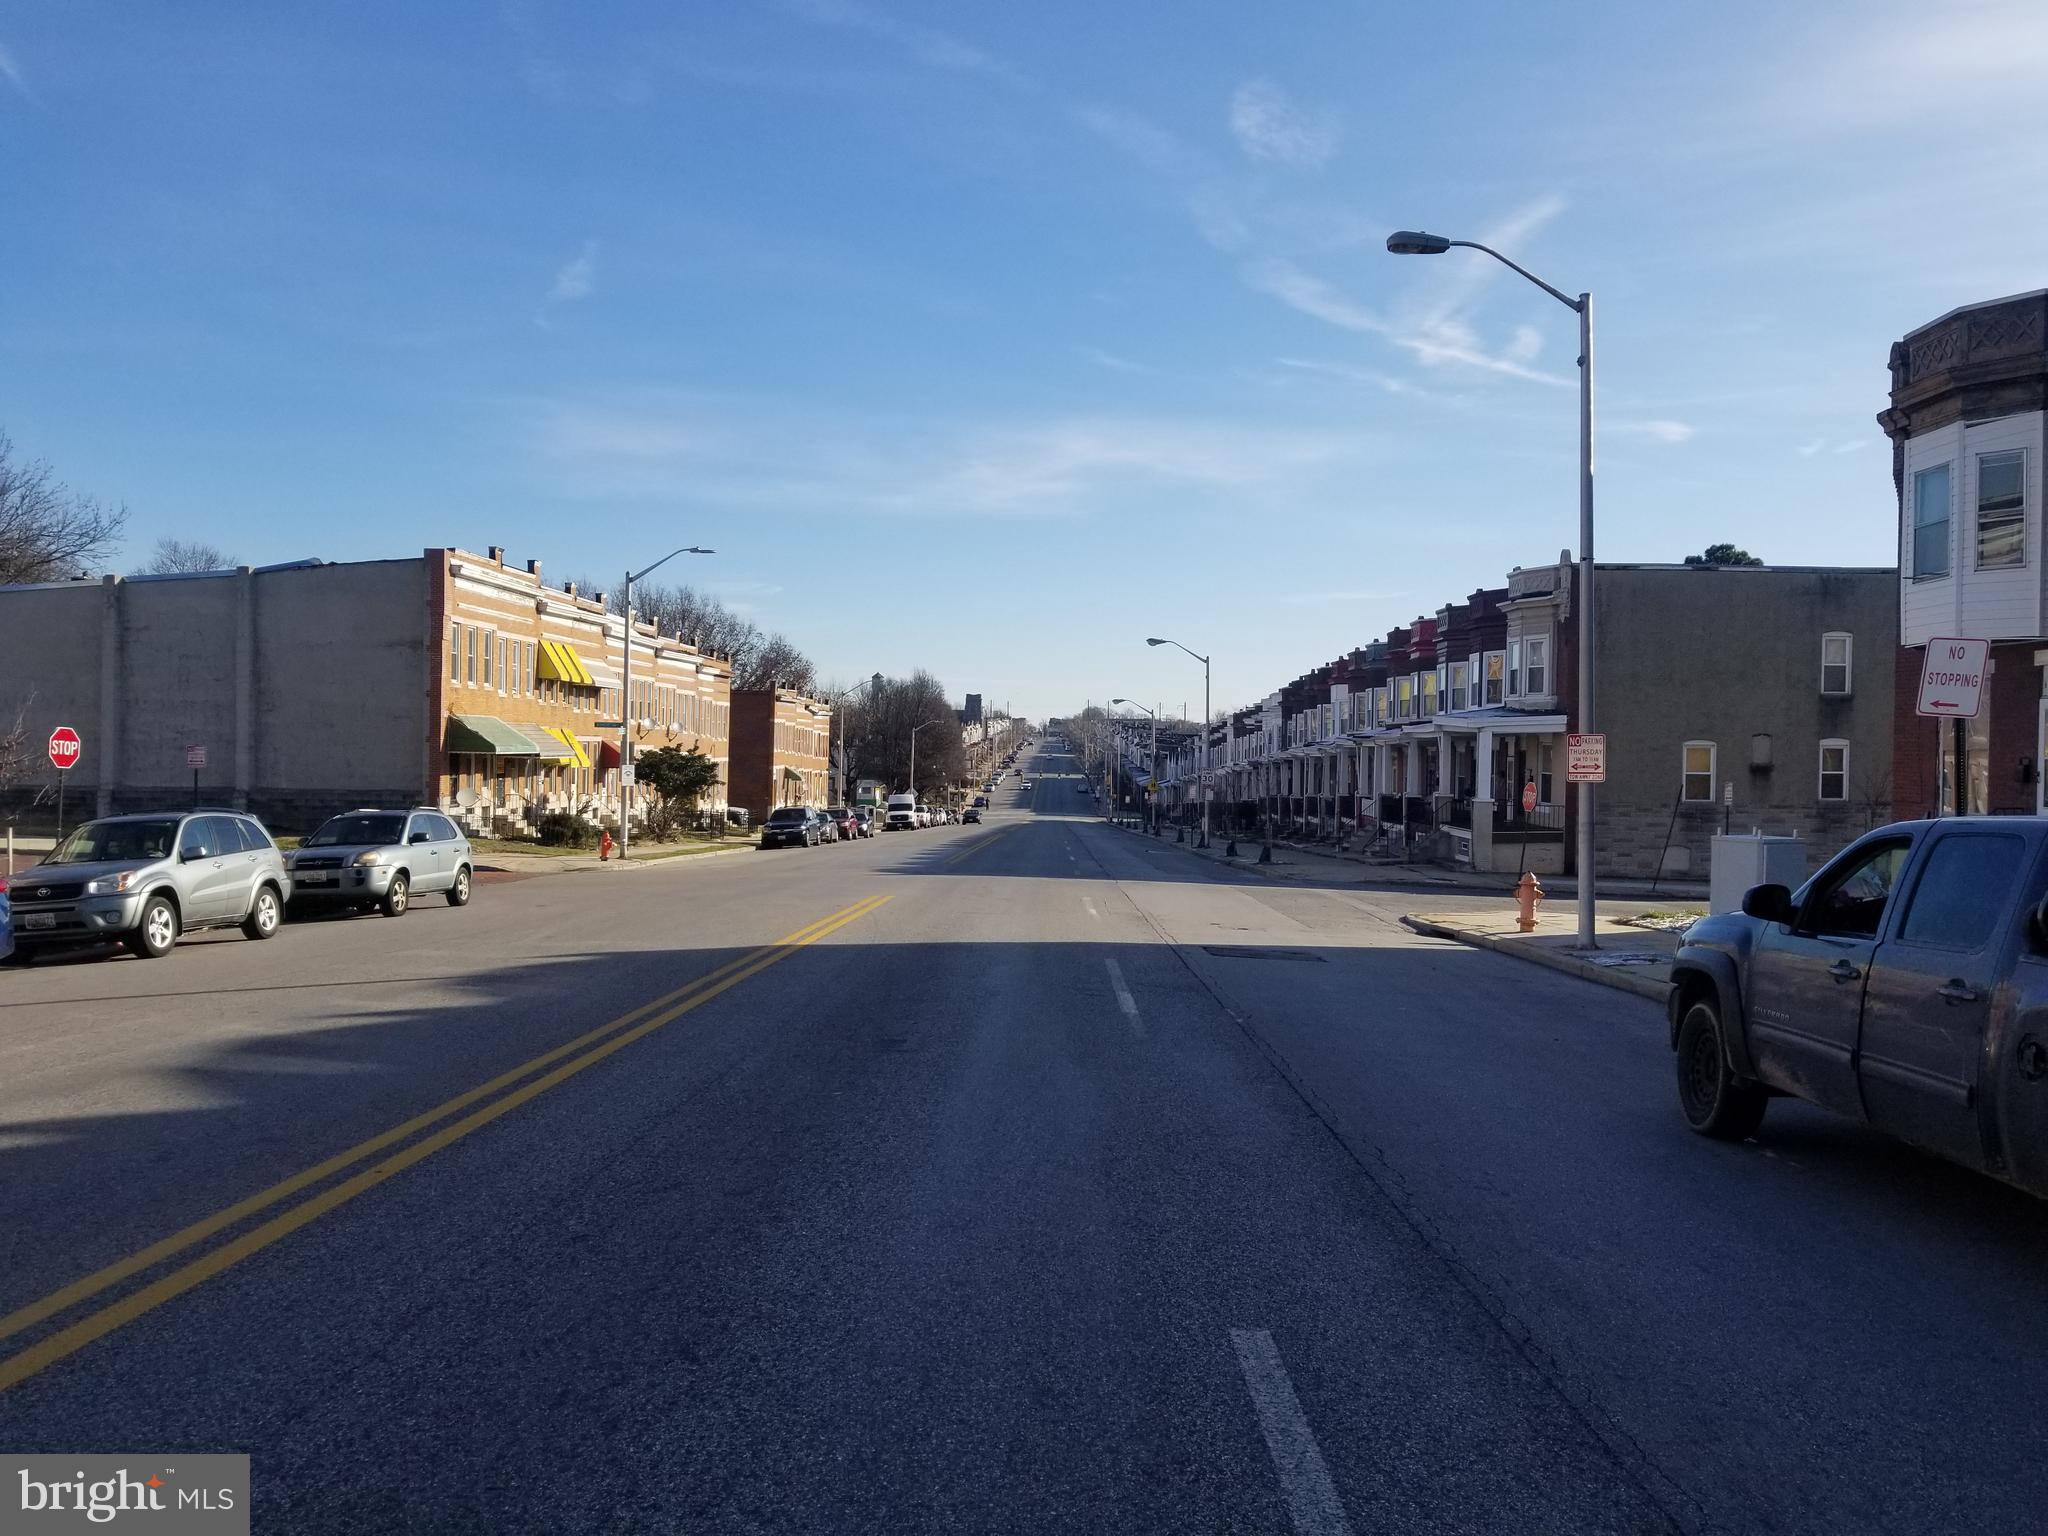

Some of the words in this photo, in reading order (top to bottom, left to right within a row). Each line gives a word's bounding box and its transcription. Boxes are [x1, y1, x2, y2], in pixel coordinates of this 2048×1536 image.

[1949, 646, 1965, 660] NO
[1927, 672, 1978, 688] STOPPING
[51, 740, 78, 756] STOP
[1569, 736, 1581, 746] NO
[1523, 791, 1536, 803] STOP
